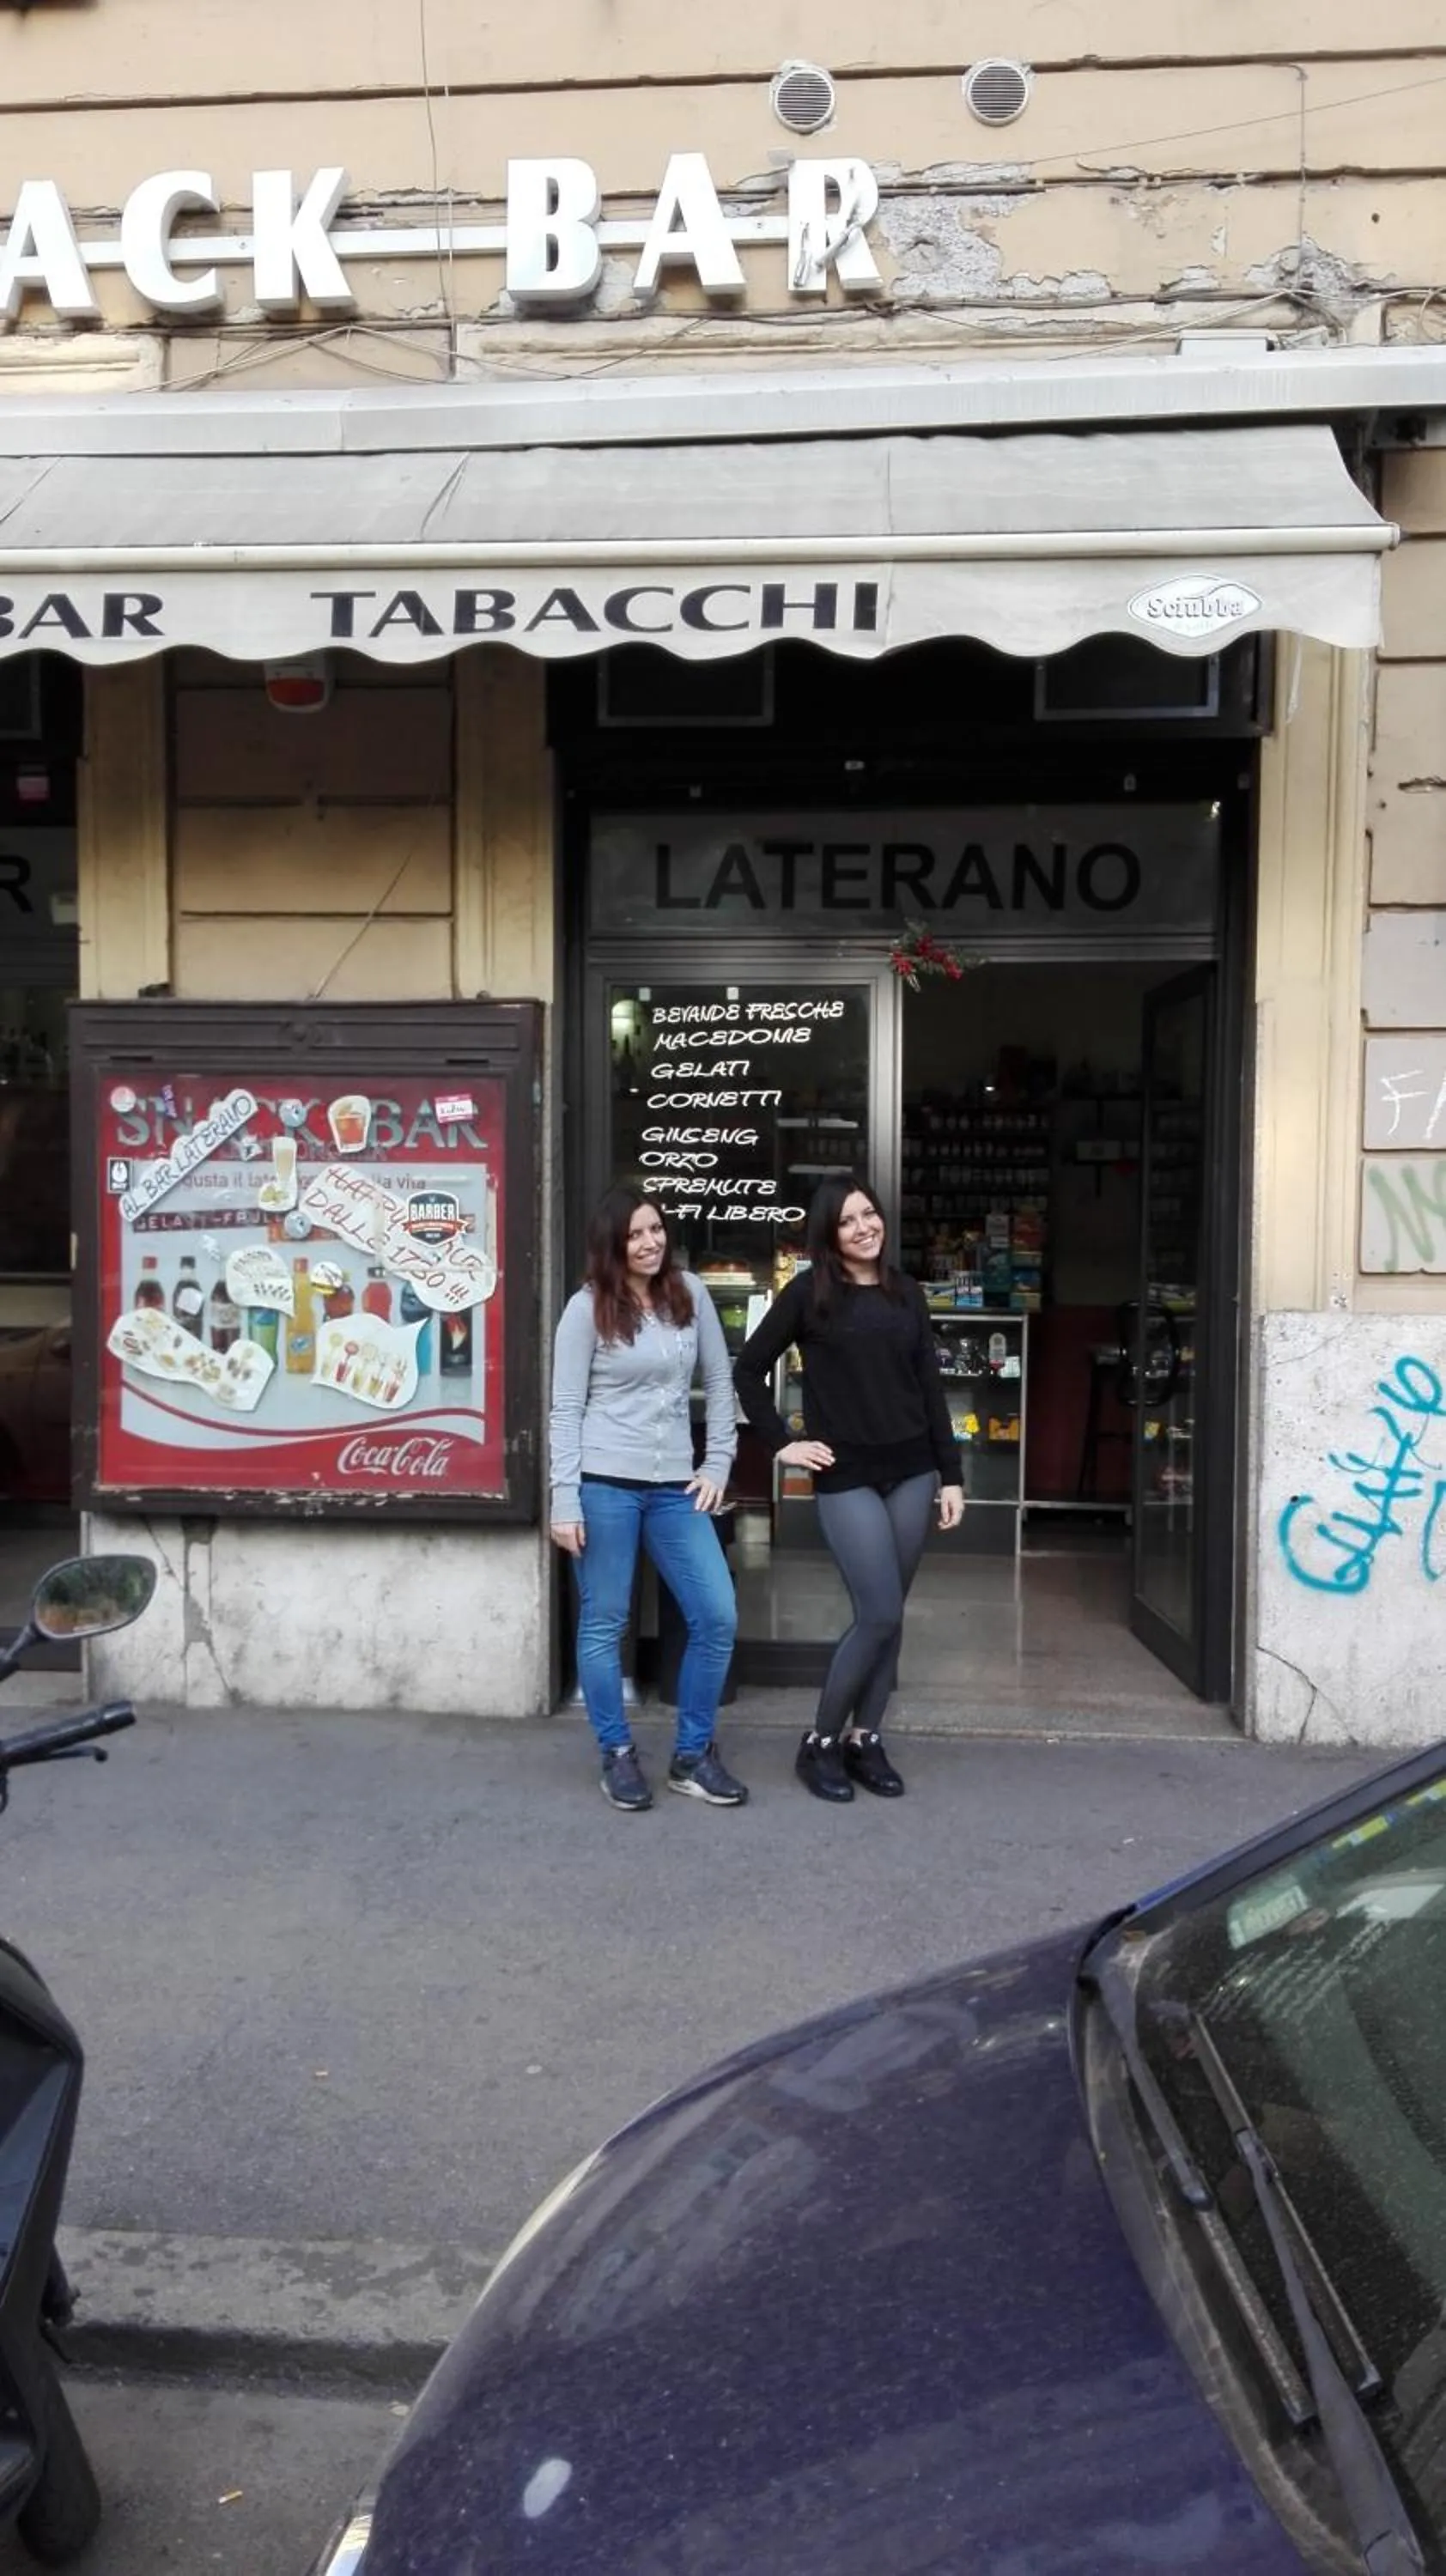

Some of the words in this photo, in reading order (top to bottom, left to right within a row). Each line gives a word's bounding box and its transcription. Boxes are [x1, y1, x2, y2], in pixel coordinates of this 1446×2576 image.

[505, 152, 884, 305] BAR
[310, 581, 878, 639] TABACCHI
[655, 839, 1141, 911] LATERANO
[745, 1001, 845, 1021] FRESCHE
[651, 1060, 750, 1079] GELATI
[647, 1091, 782, 1109] CORNETTI
[641, 1127, 759, 1146] GINSENG
[639, 1151, 719, 1174] ORZO
[143, 1163, 179, 1199] BAR
[643, 1177, 777, 1197] SPREMUTE
[410, 1203, 454, 1219] BARBER
[707, 1206, 806, 1223] LIBERO
